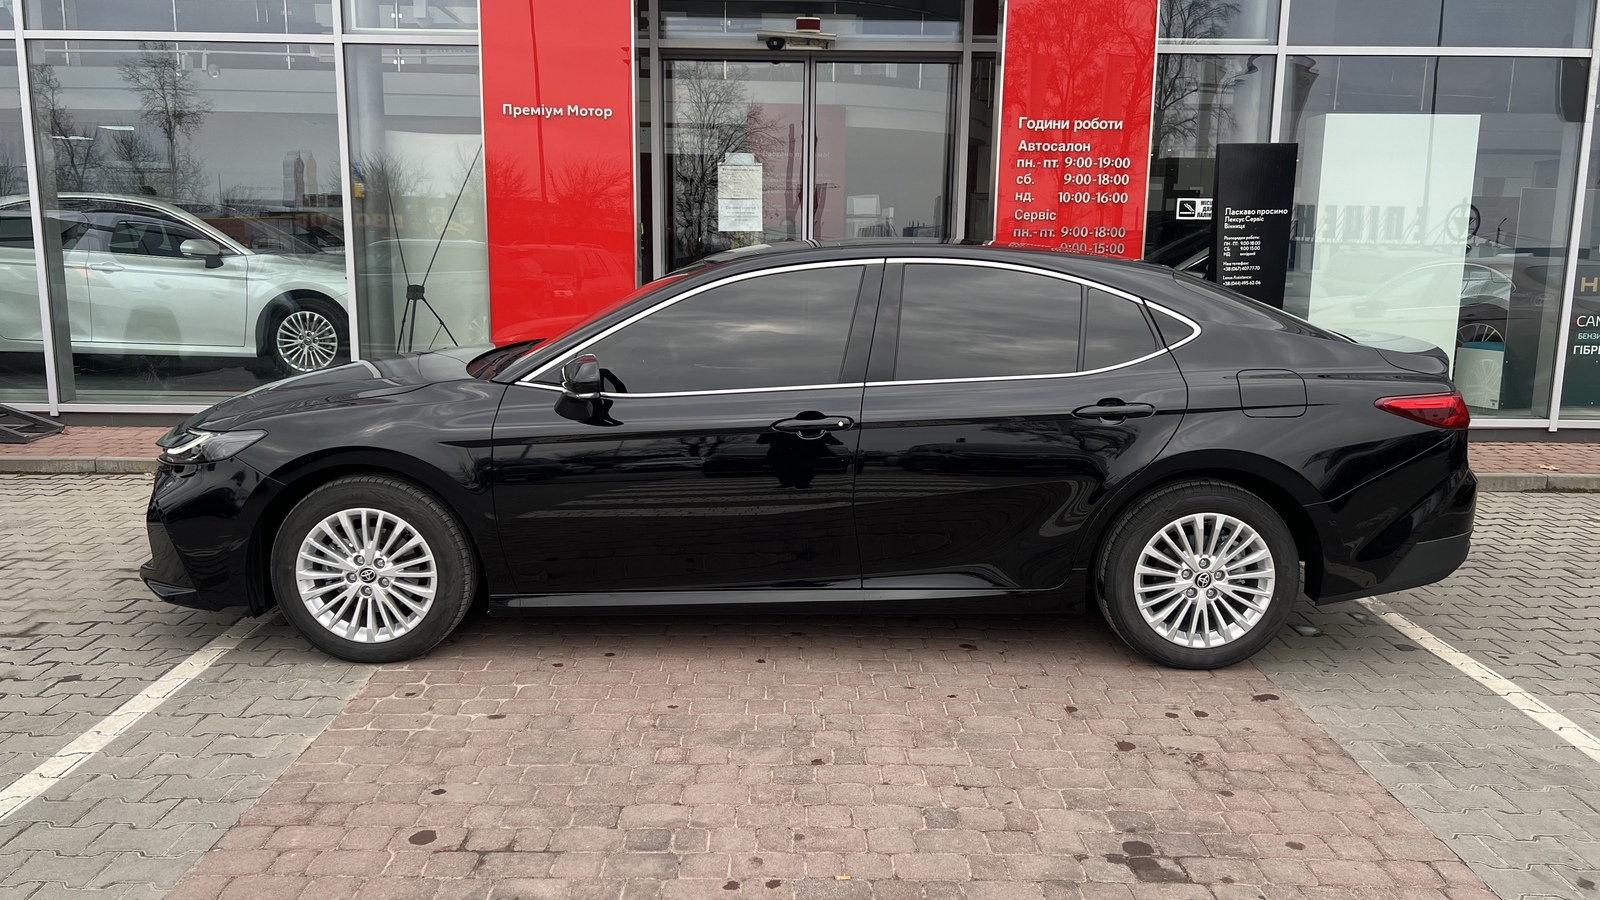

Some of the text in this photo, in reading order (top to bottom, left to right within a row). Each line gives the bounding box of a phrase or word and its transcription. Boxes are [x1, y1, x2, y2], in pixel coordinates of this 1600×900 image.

[502, 103, 613, 120] Преміум Мотор
[1018, 116, 1123, 133] Години роботи
[1017, 139, 1091, 152] Автосалон
[1016, 173, 1035, 185] сб.
[1015, 192, 1035, 203] нд.
[1014, 208, 1057, 223] Сервіс
[1224, 207, 1289, 217] Ласкаво просимо
[1245, 215, 1265, 223] Сервіс
